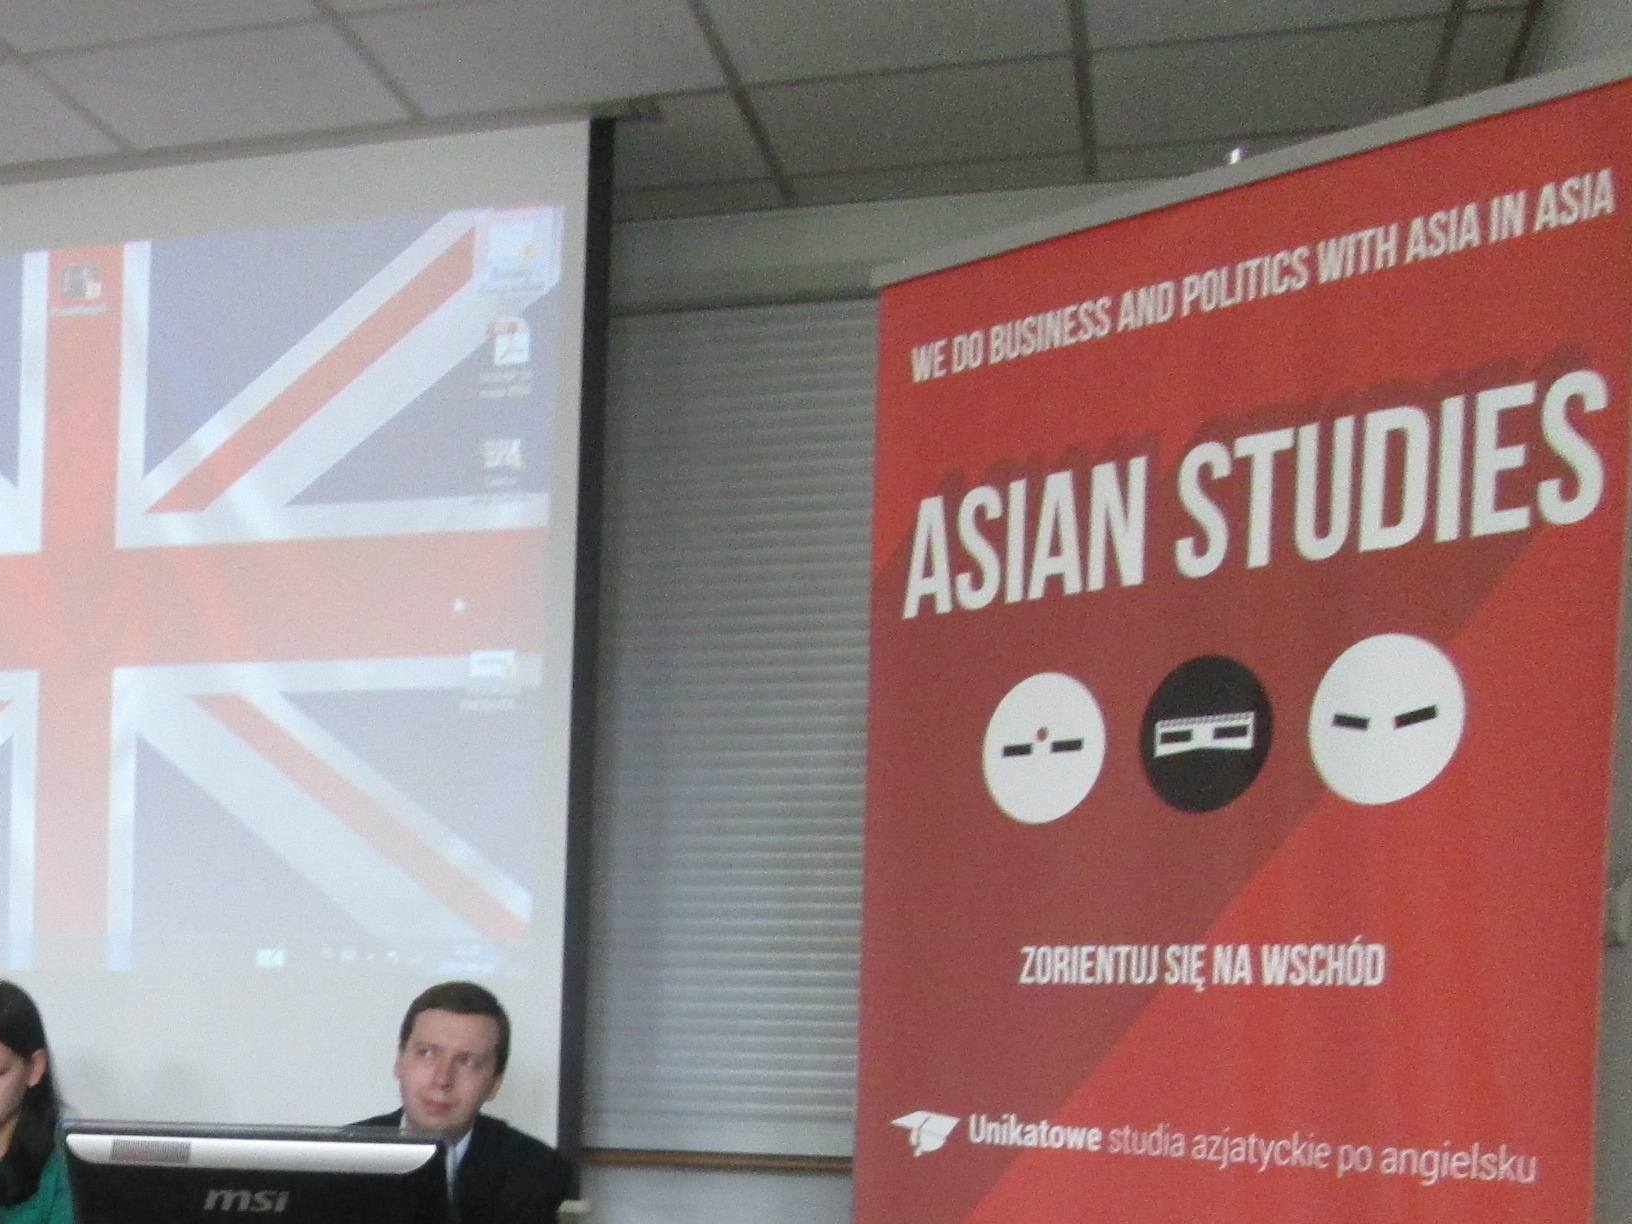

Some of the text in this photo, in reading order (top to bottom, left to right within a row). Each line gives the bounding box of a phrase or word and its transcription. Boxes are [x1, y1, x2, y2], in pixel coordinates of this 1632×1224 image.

[911, 167, 1616, 383] WE DO BUSINESS AND POLITICS WITH ASIA IN ASIA
[902, 368, 1609, 620] ASIAN STUDIES
[1018, 935, 1386, 993] ZORIENTUJ SIĘ NA WSCHÓD
[968, 1113, 1538, 1187] Unikatowe studia azjatyckie po angielsku
